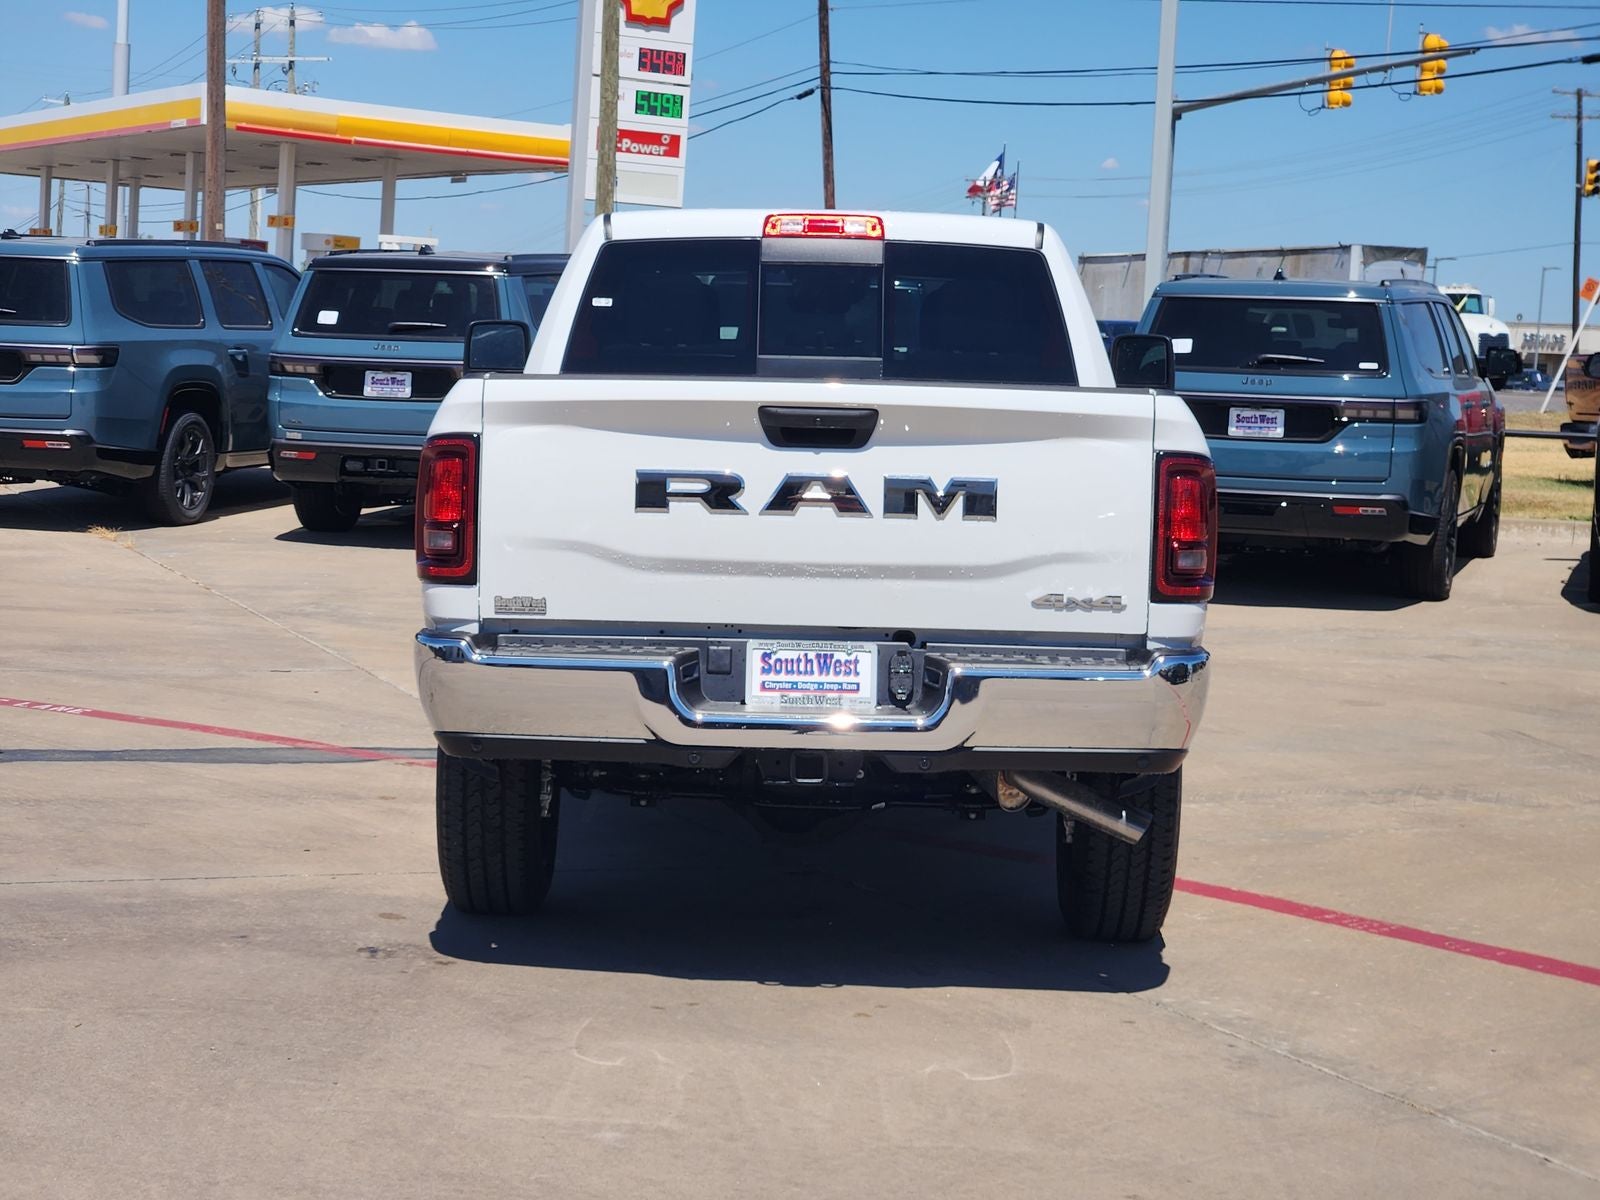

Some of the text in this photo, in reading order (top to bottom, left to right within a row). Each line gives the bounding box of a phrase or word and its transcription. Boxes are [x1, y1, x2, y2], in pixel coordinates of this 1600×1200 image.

[1241, 377, 1273, 387] Jeep
[635, 469, 998, 521] RAM
[760, 651, 860, 678] SouthWest
[764, 681, 858, 692] Chrysler Dodge Jeep Ram
